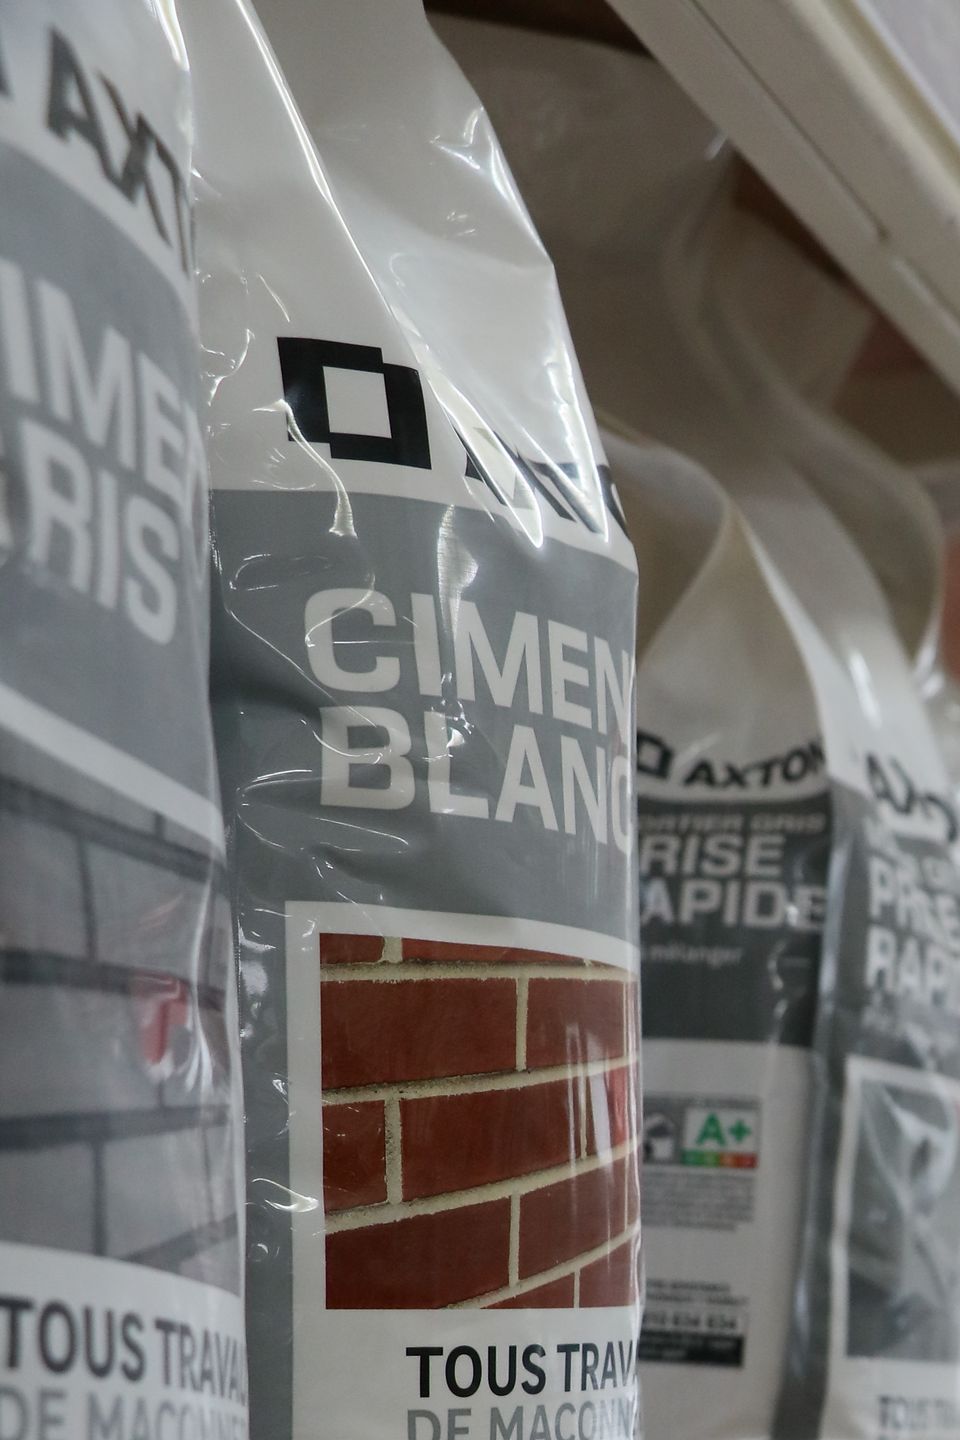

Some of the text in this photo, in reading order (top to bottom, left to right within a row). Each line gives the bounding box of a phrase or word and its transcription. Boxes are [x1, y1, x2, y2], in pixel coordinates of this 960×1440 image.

[0, 418, 178, 645] RIS
[304, 588, 633, 745] CIMEN
[640, 832, 787, 880] RISE
[640, 876, 828, 933] APIDE
[696, 1112, 752, 1147] A+
[0, 1296, 248, 1406] TOUS TRAVA
[405, 1344, 547, 1398] TOUS
[556, 1340, 637, 1393] TRAV
